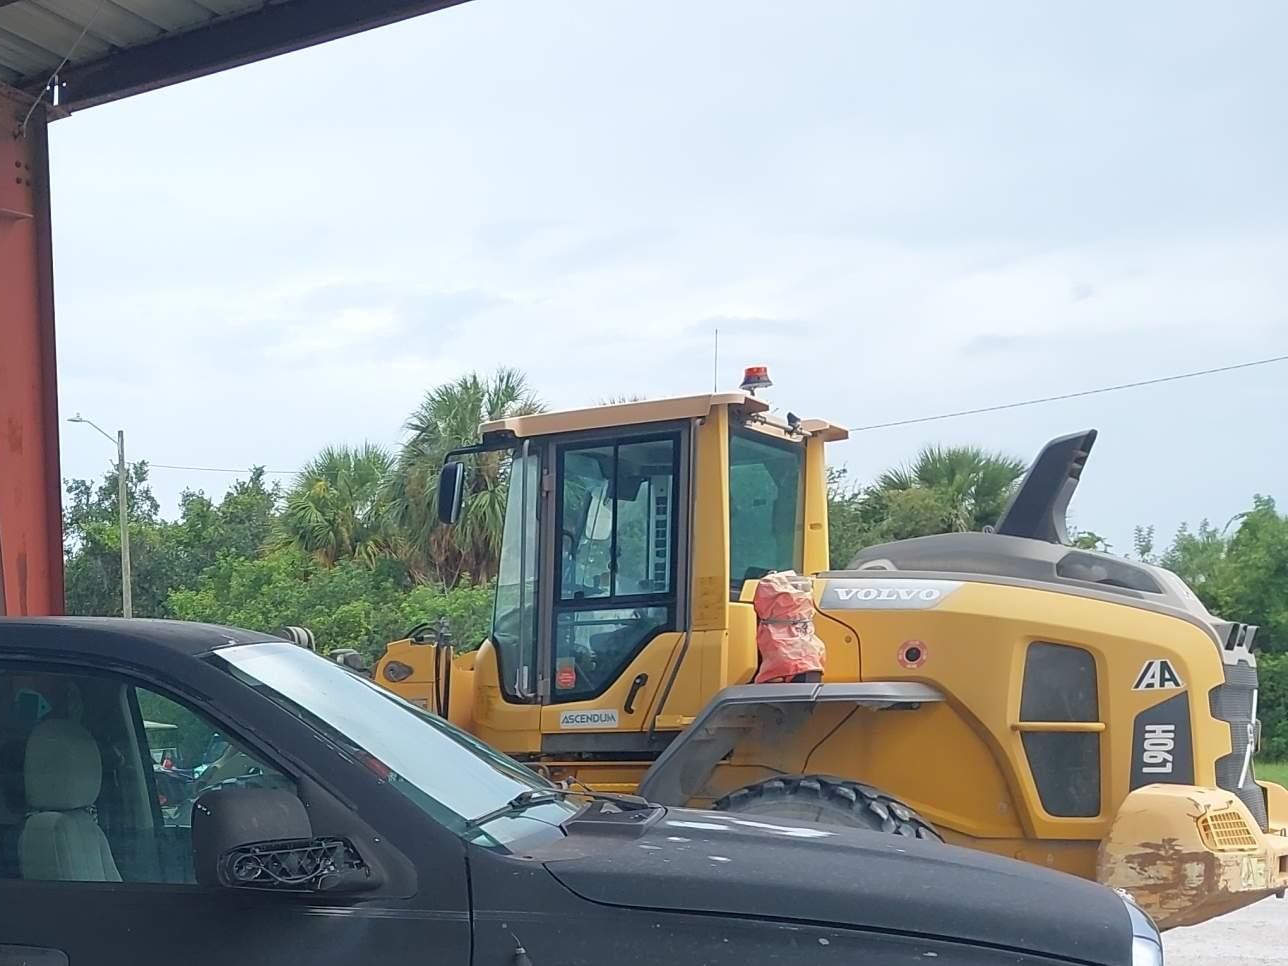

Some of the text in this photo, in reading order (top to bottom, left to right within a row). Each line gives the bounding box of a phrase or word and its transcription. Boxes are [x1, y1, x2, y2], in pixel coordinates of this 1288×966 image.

[834, 588, 941, 601] VOLVO
[561, 713, 617, 724] ASCENDUM
[1142, 724, 1176, 774] L90H
